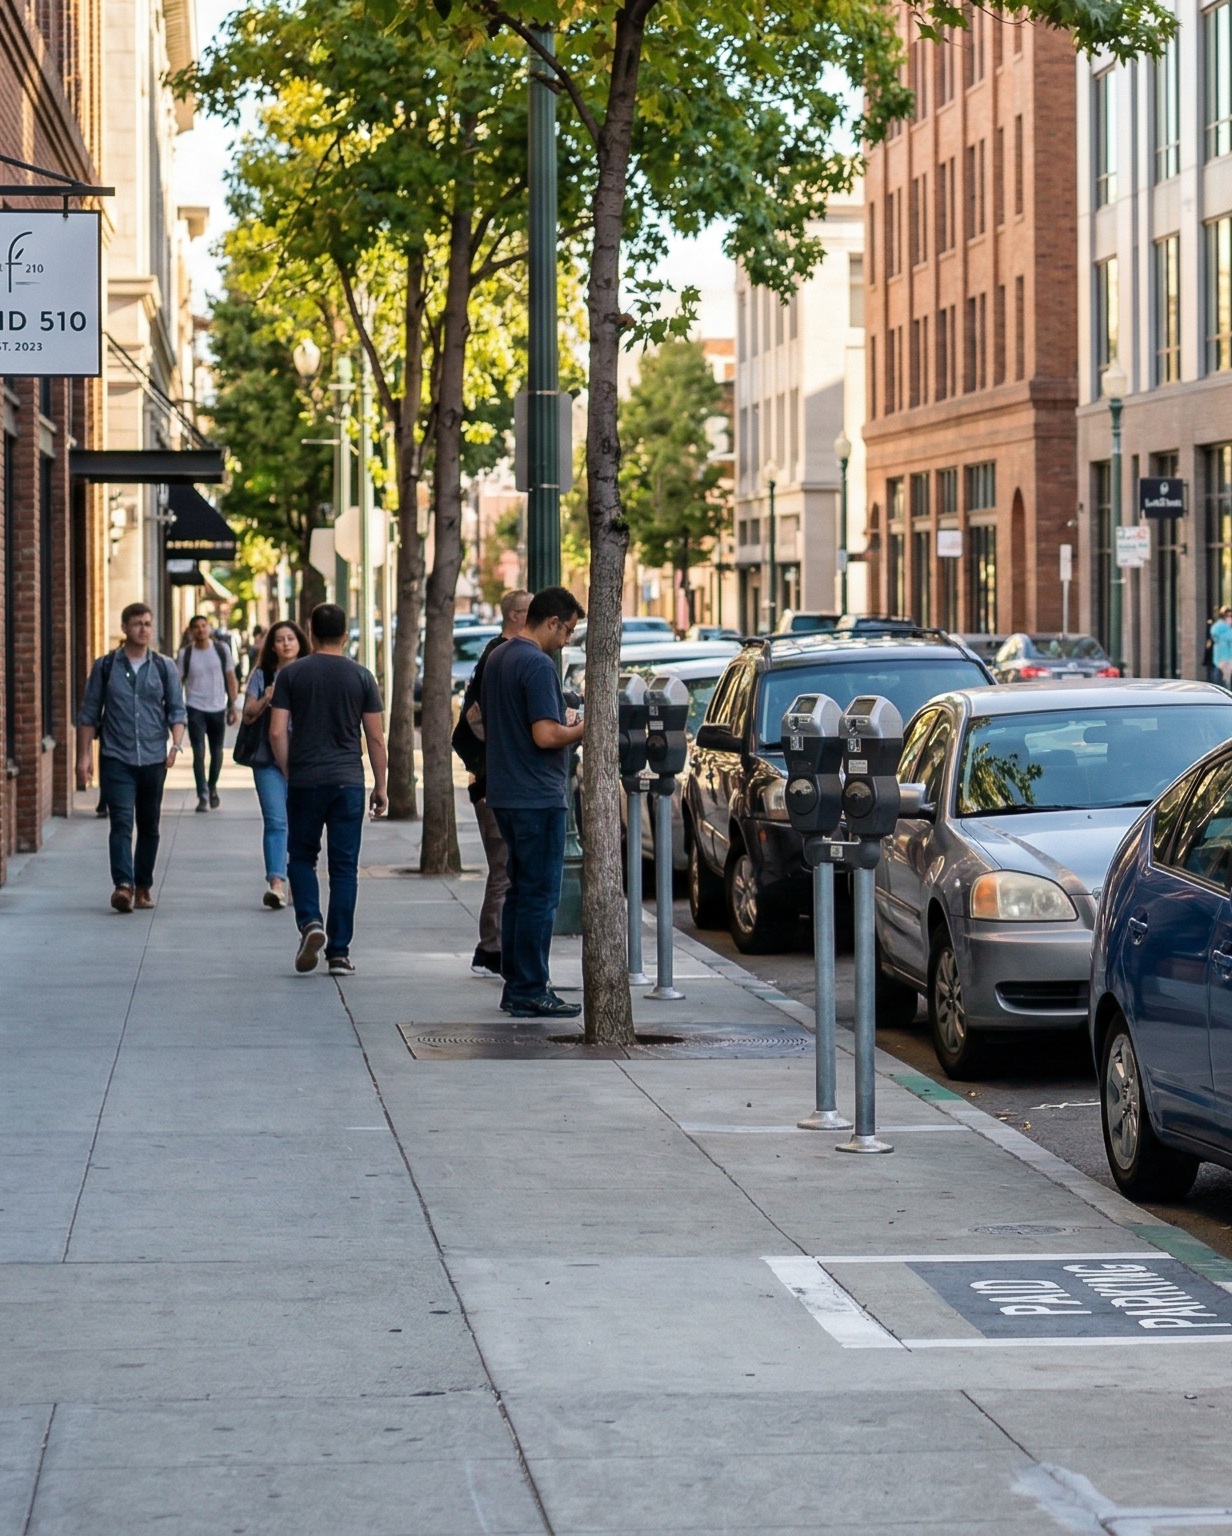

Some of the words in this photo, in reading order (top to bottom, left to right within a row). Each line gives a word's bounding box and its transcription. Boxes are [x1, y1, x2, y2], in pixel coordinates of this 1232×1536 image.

[26, 264, 44, 273] 210
[40, 311, 86, 331] 510
[0, 342, 11, 351] T.
[15, 342, 43, 352] 2023
[970, 1279, 1092, 1316] PAID
[1063, 1263, 1232, 1329] PARKING
